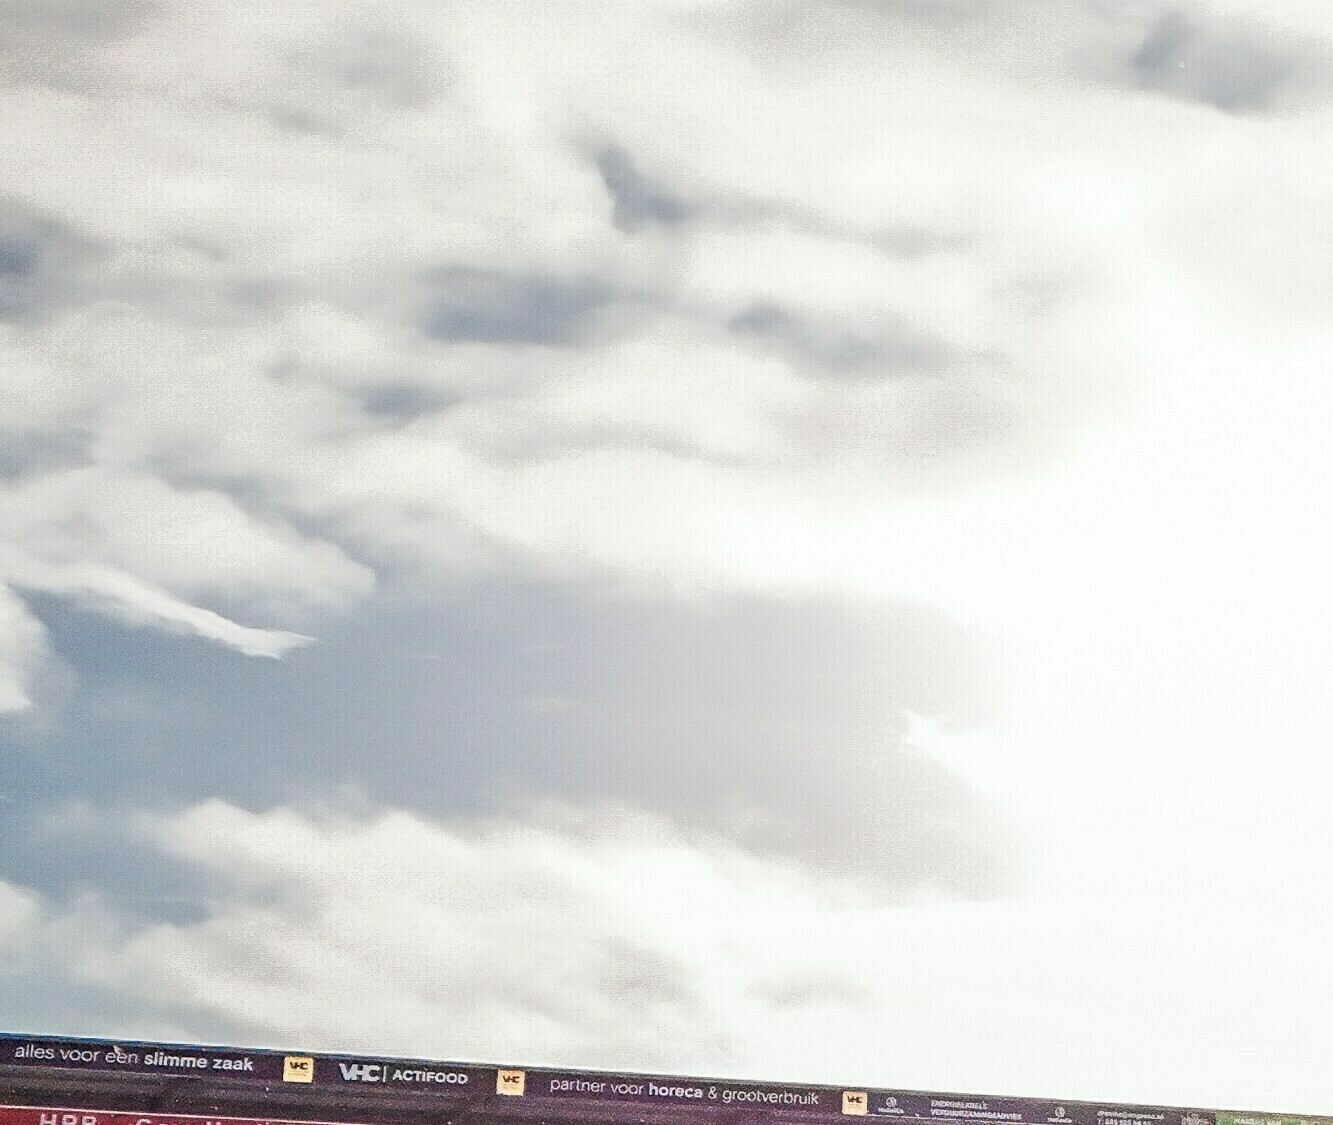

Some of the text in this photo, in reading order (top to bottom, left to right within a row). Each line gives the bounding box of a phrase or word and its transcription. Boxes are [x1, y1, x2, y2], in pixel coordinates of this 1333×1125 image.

[14, 1043, 254, 1072] alles voor een slimme zaak
[289, 1061, 309, 1071] VHC
[339, 1063, 468, 1085] VHC ACTIFOOD
[550, 1077, 819, 1107] partner voor horeca & grootverbruik
